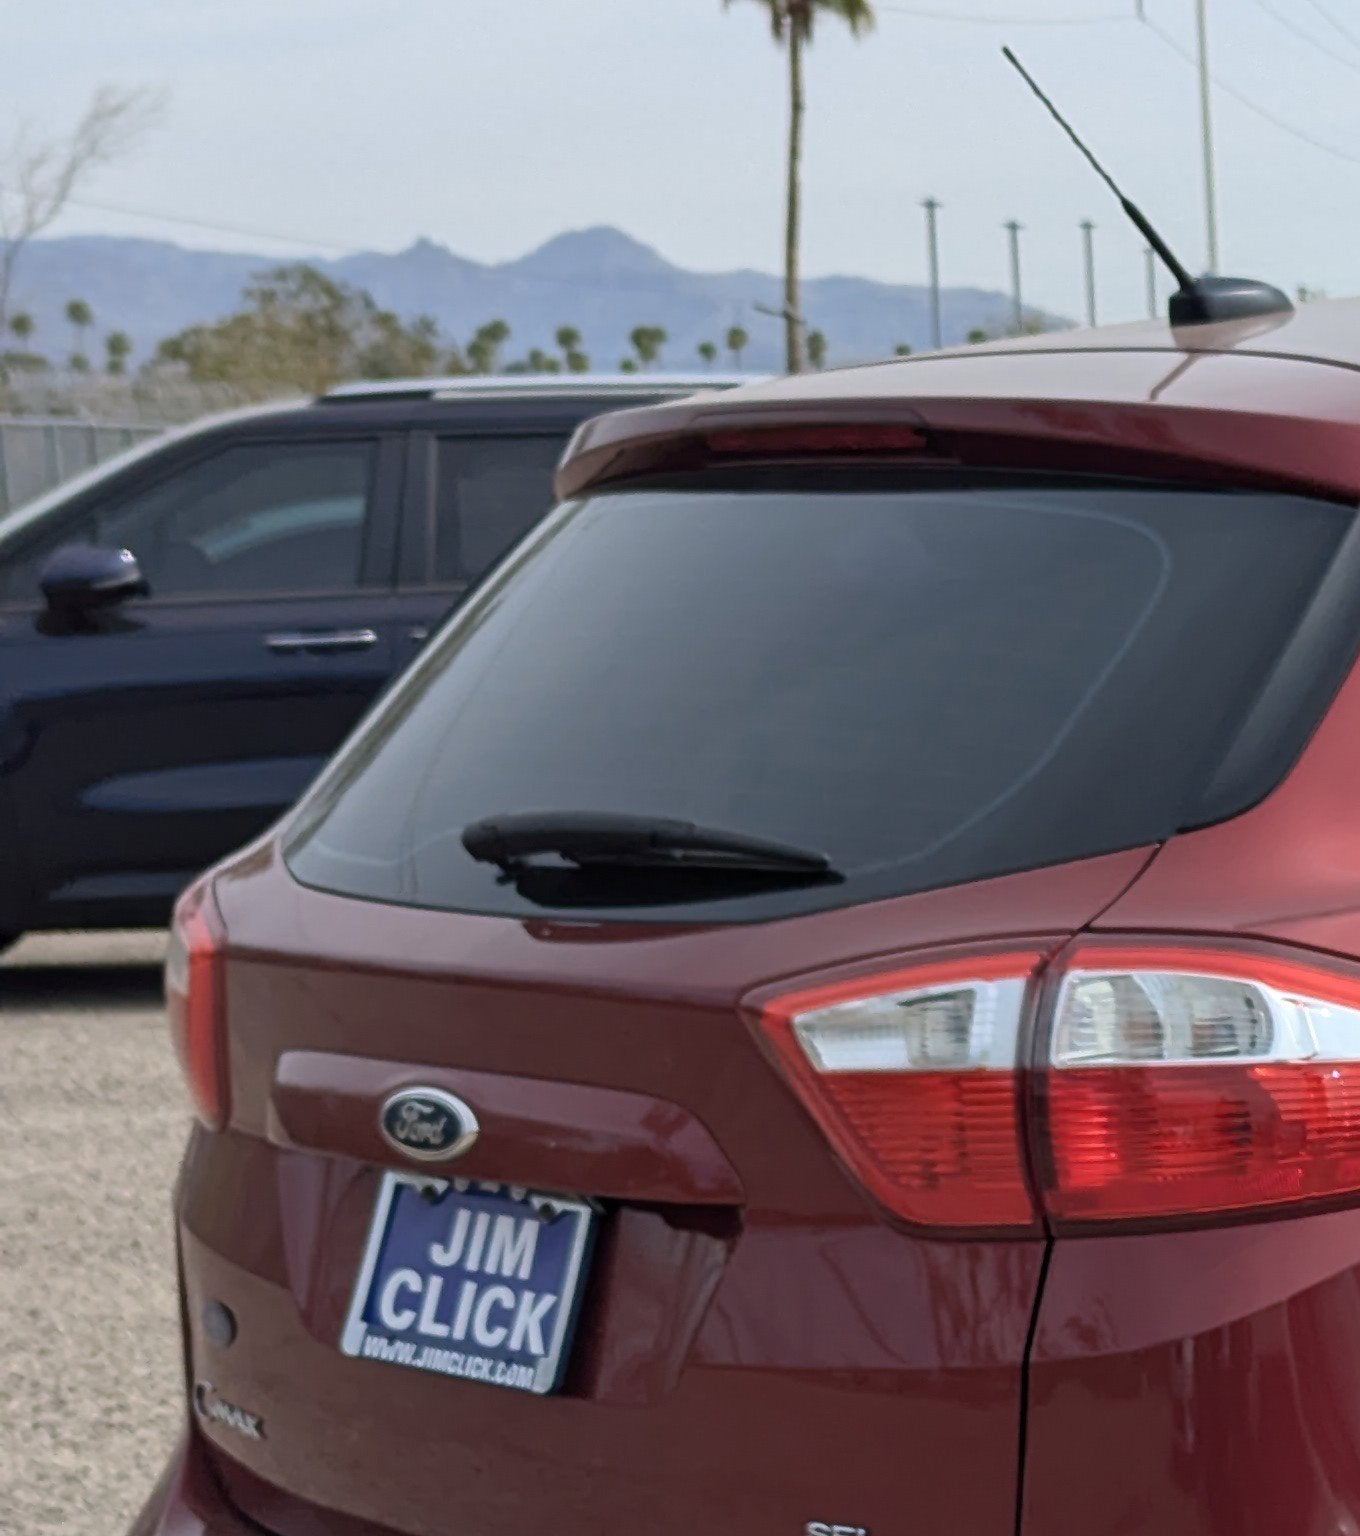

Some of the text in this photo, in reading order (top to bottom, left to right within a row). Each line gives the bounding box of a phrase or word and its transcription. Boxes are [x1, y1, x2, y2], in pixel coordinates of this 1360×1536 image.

[394, 1099, 449, 1147] Ford
[429, 1207, 541, 1281] JIM
[380, 1267, 559, 1356] CLICK
